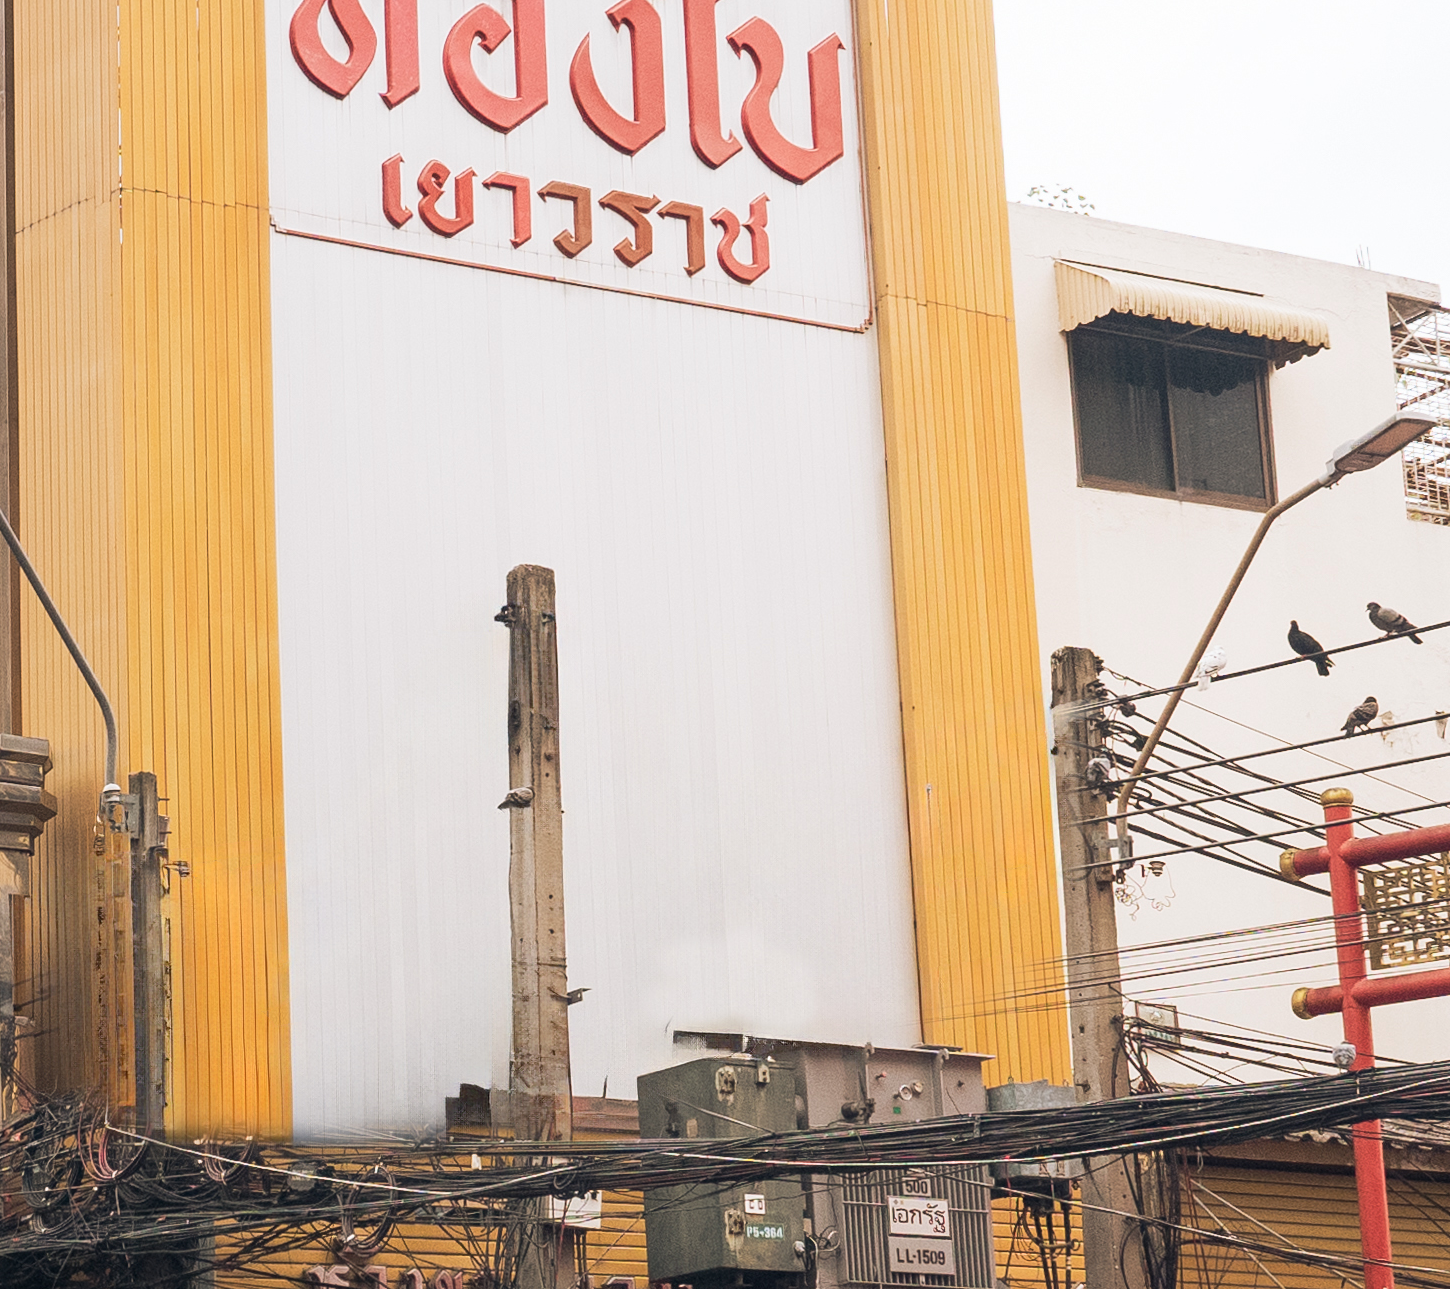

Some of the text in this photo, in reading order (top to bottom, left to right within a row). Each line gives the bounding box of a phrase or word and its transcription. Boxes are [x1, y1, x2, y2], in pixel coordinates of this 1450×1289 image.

[381, 152, 771, 284] เยาวราช
[906, 1180, 928, 1194] 500
[891, 1203, 947, 1234] เอกรัฐ
[896, 1247, 947, 1266] LL-1509
